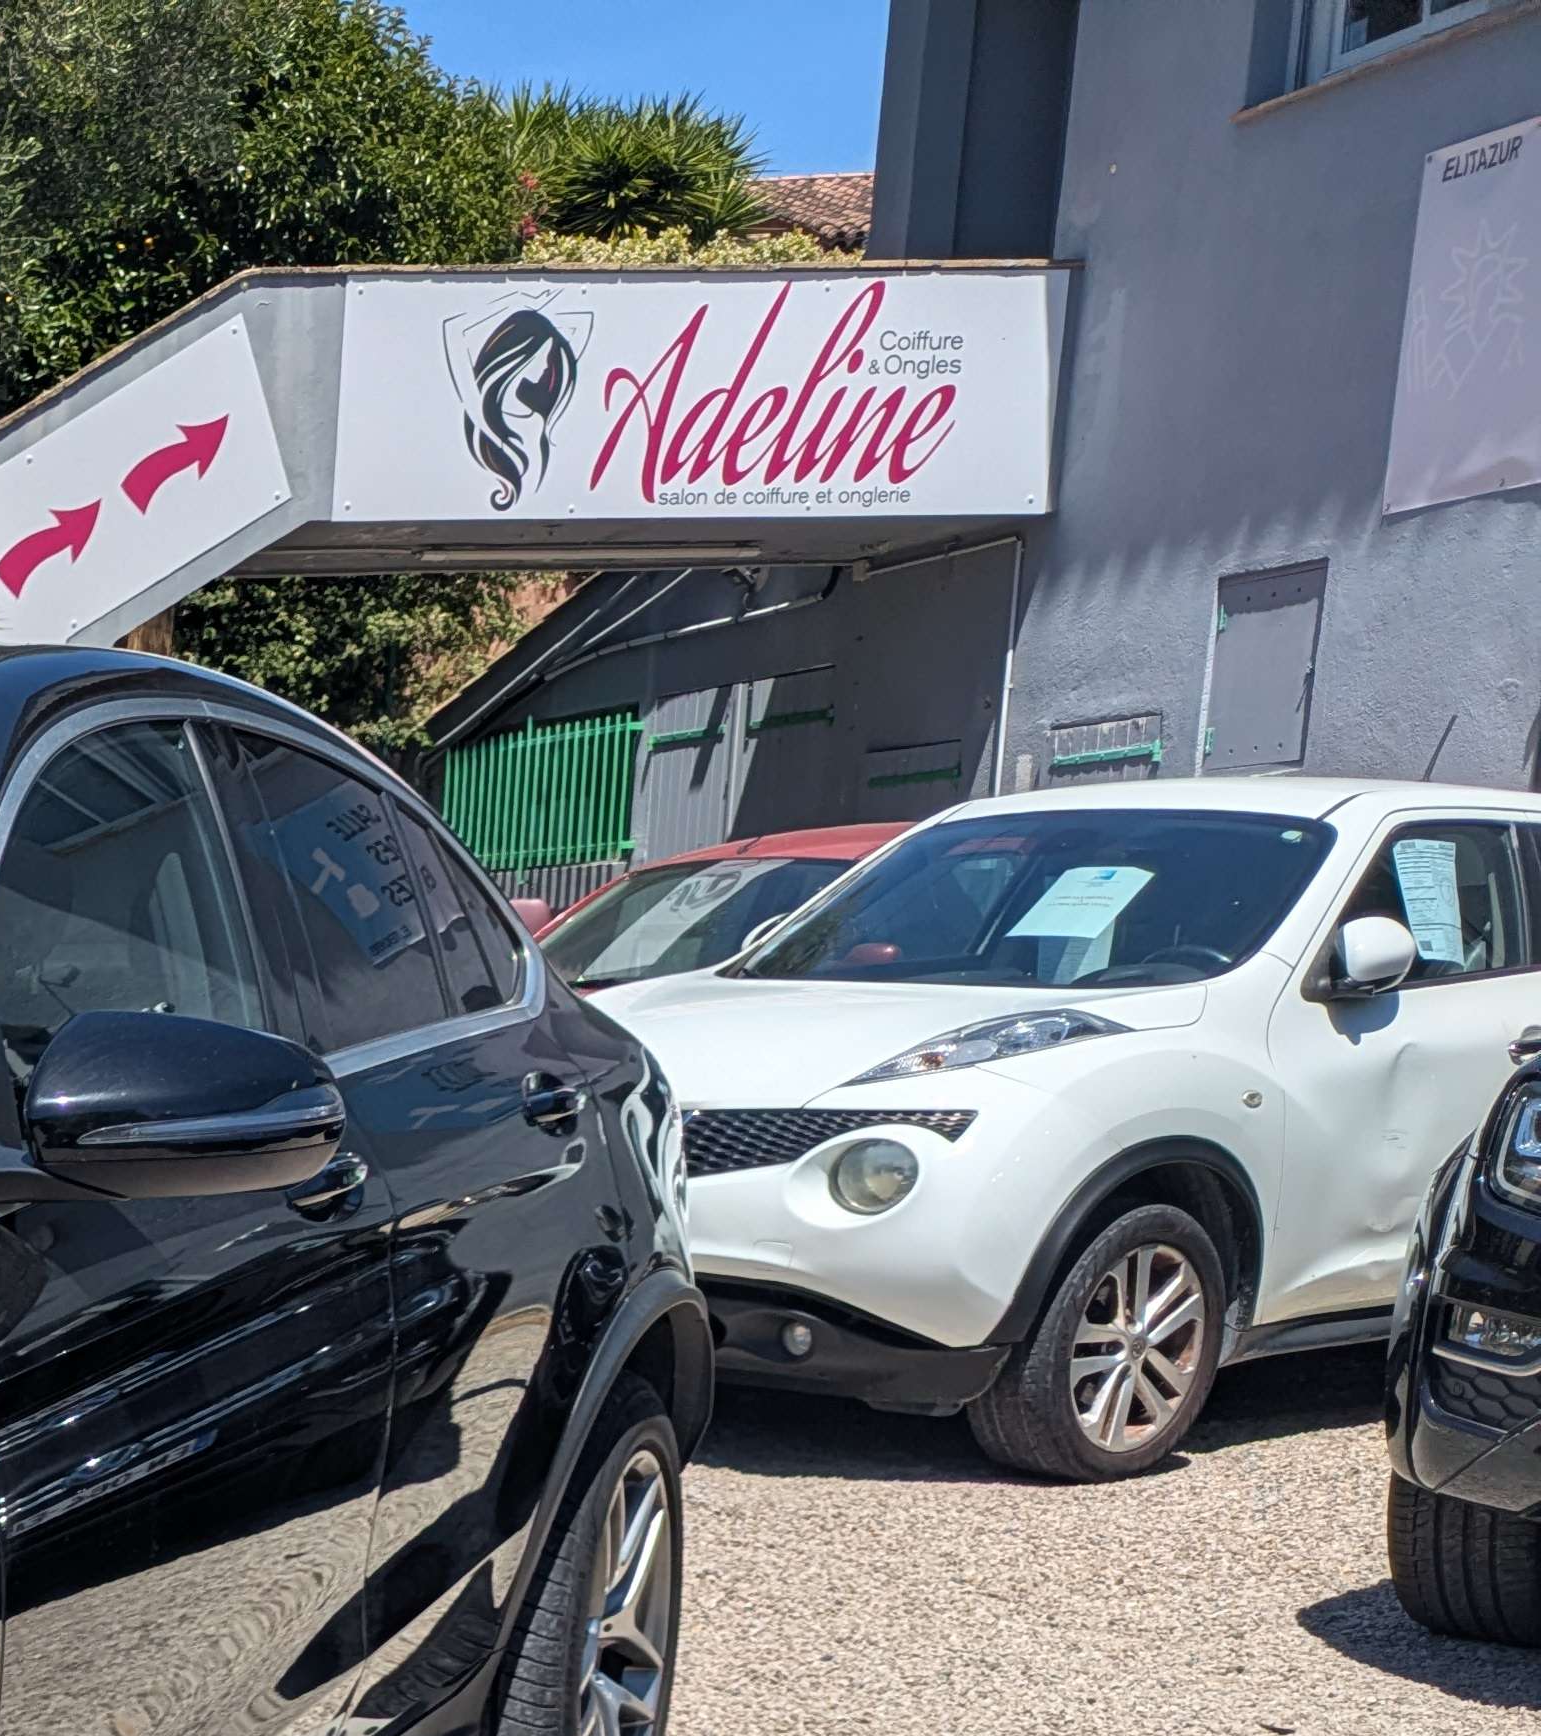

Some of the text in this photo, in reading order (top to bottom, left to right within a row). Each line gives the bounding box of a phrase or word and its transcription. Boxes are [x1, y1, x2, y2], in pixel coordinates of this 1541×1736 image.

[1441, 135, 1523, 183] ELITAZUR
[879, 330, 964, 351] Coiffure
[868, 354, 962, 379] & Ongles
[588, 278, 957, 503] Adeline
[658, 486, 911, 508] salon de coiffure et onglerie
